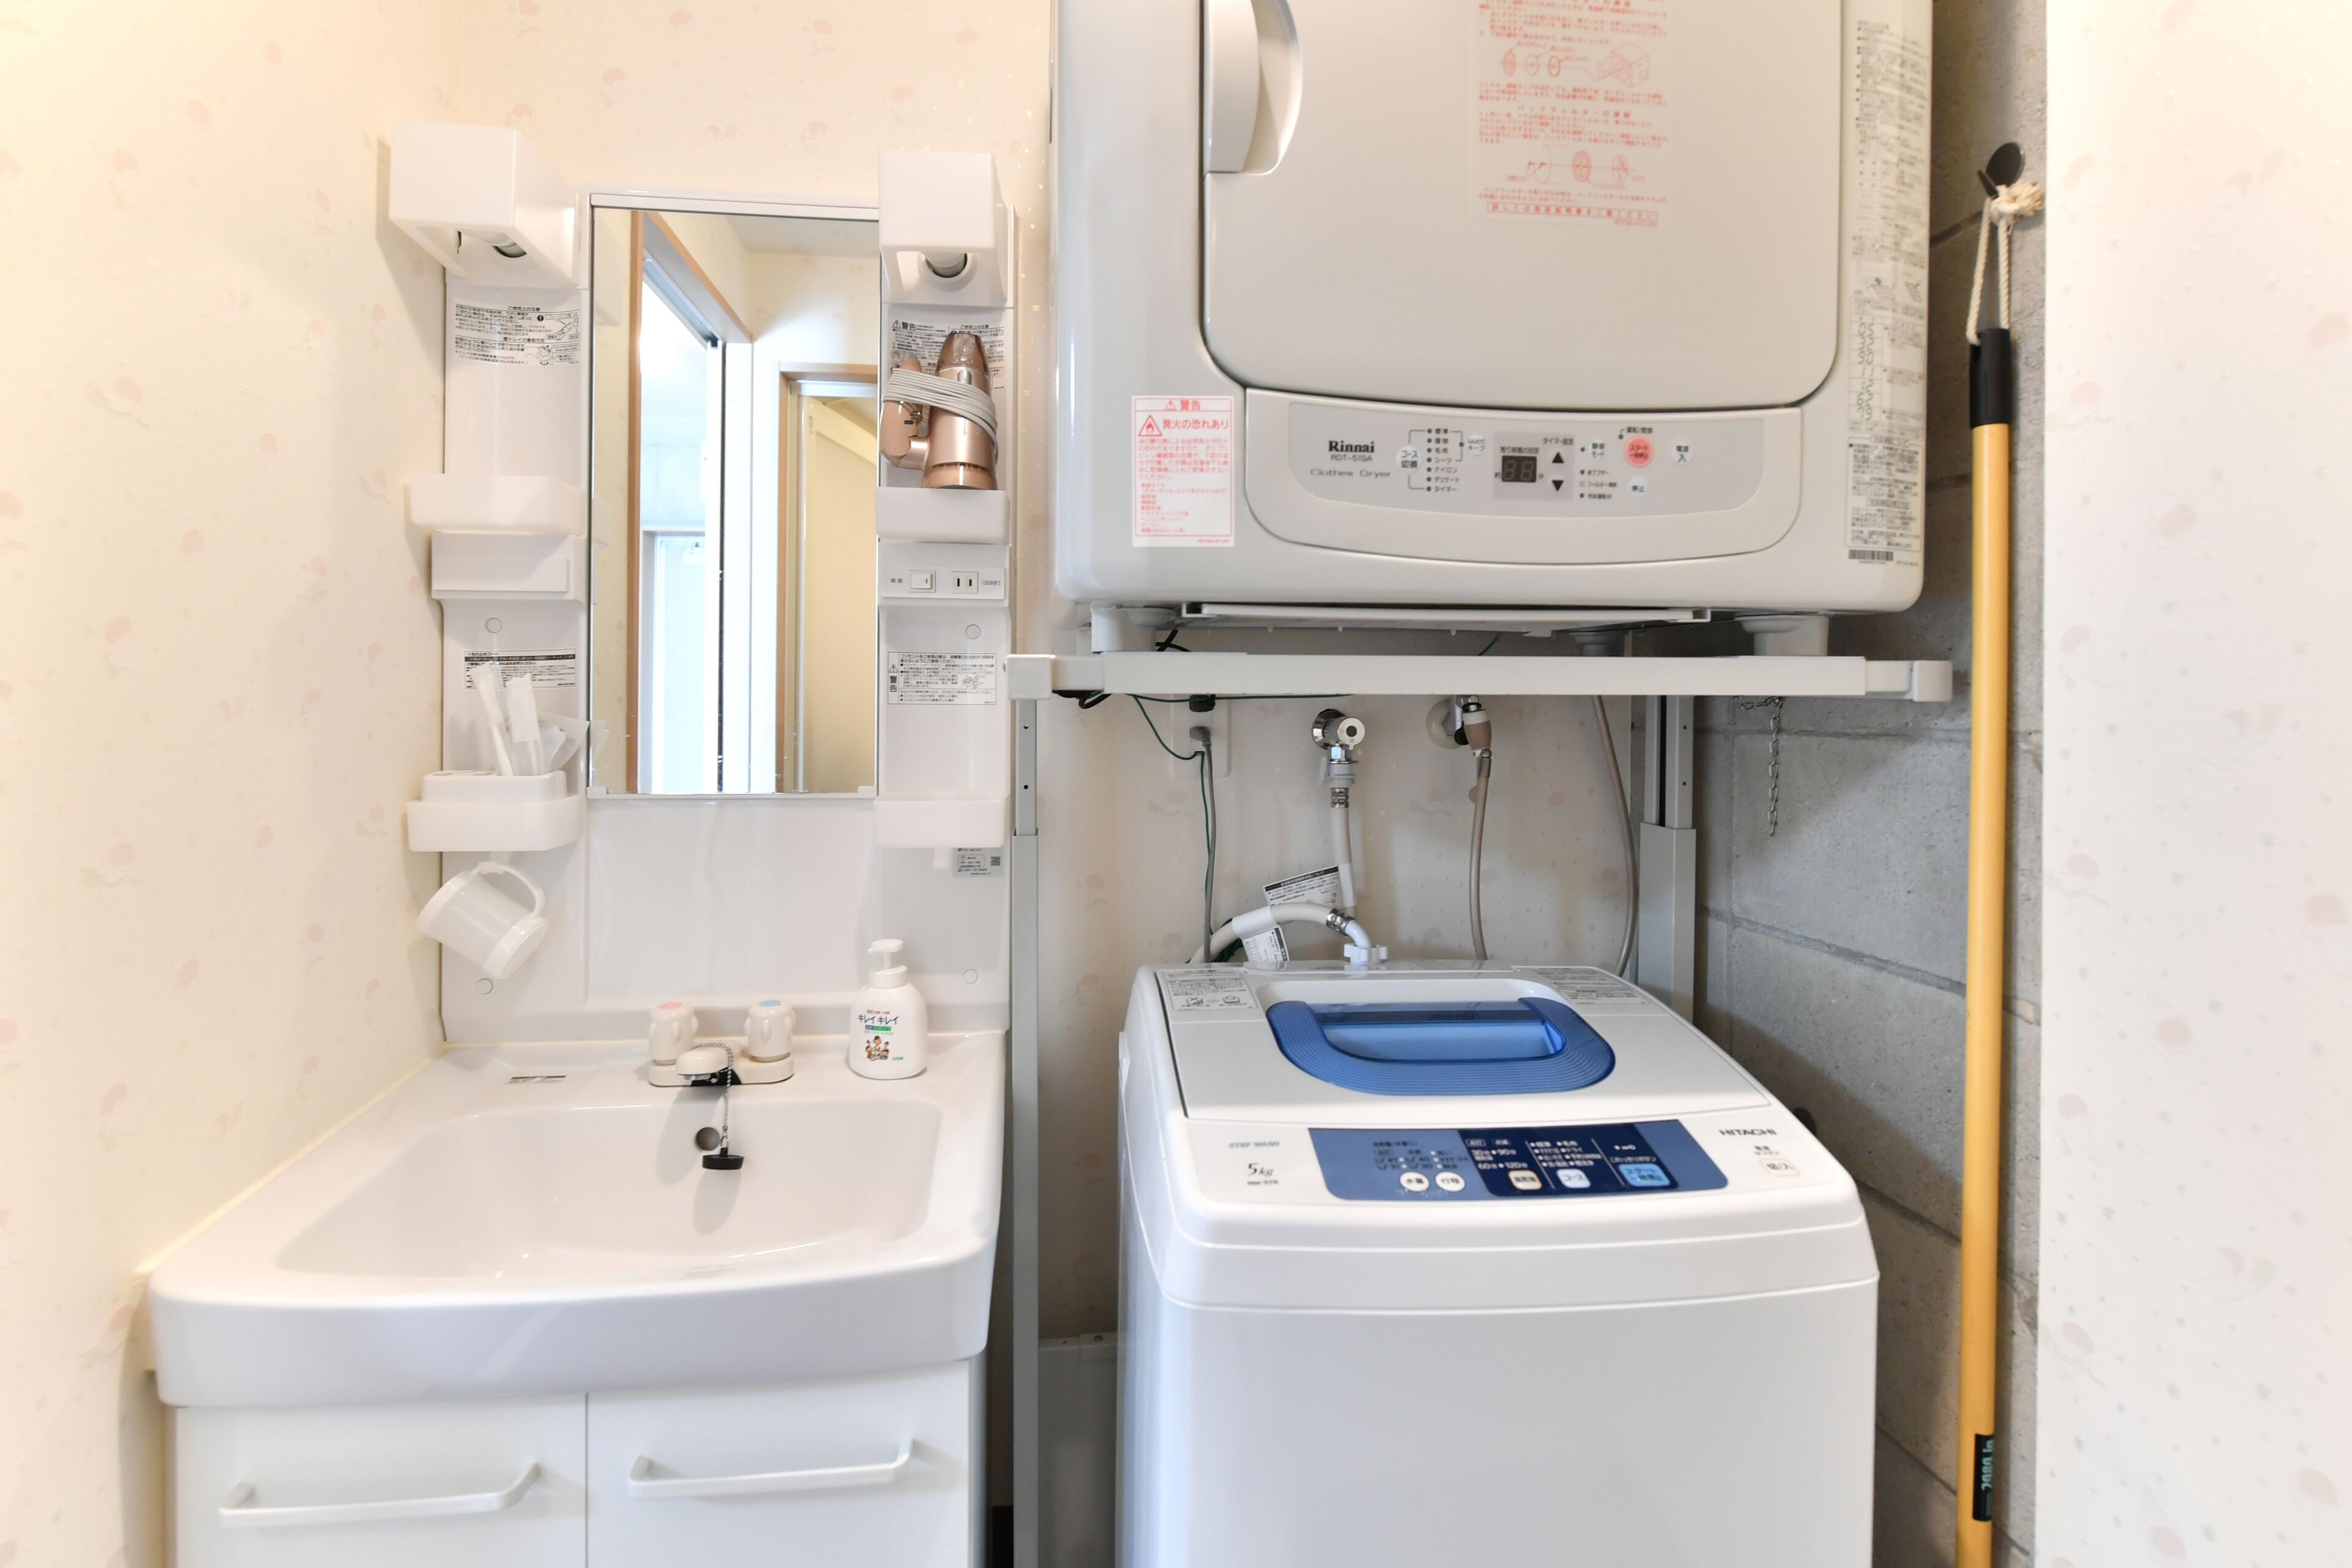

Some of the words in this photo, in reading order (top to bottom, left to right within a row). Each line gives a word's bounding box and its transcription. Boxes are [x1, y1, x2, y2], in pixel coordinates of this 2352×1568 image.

[902, 322, 916, 331] 警告
[1163, 419, 1229, 429] 発火の恐れあり
[1329, 440, 1374, 453] Rinnai
[1677, 453, 1687, 462] 入
[1310, 468, 1354, 477] Clothes
[1359, 469, 1390, 478] Dryer
